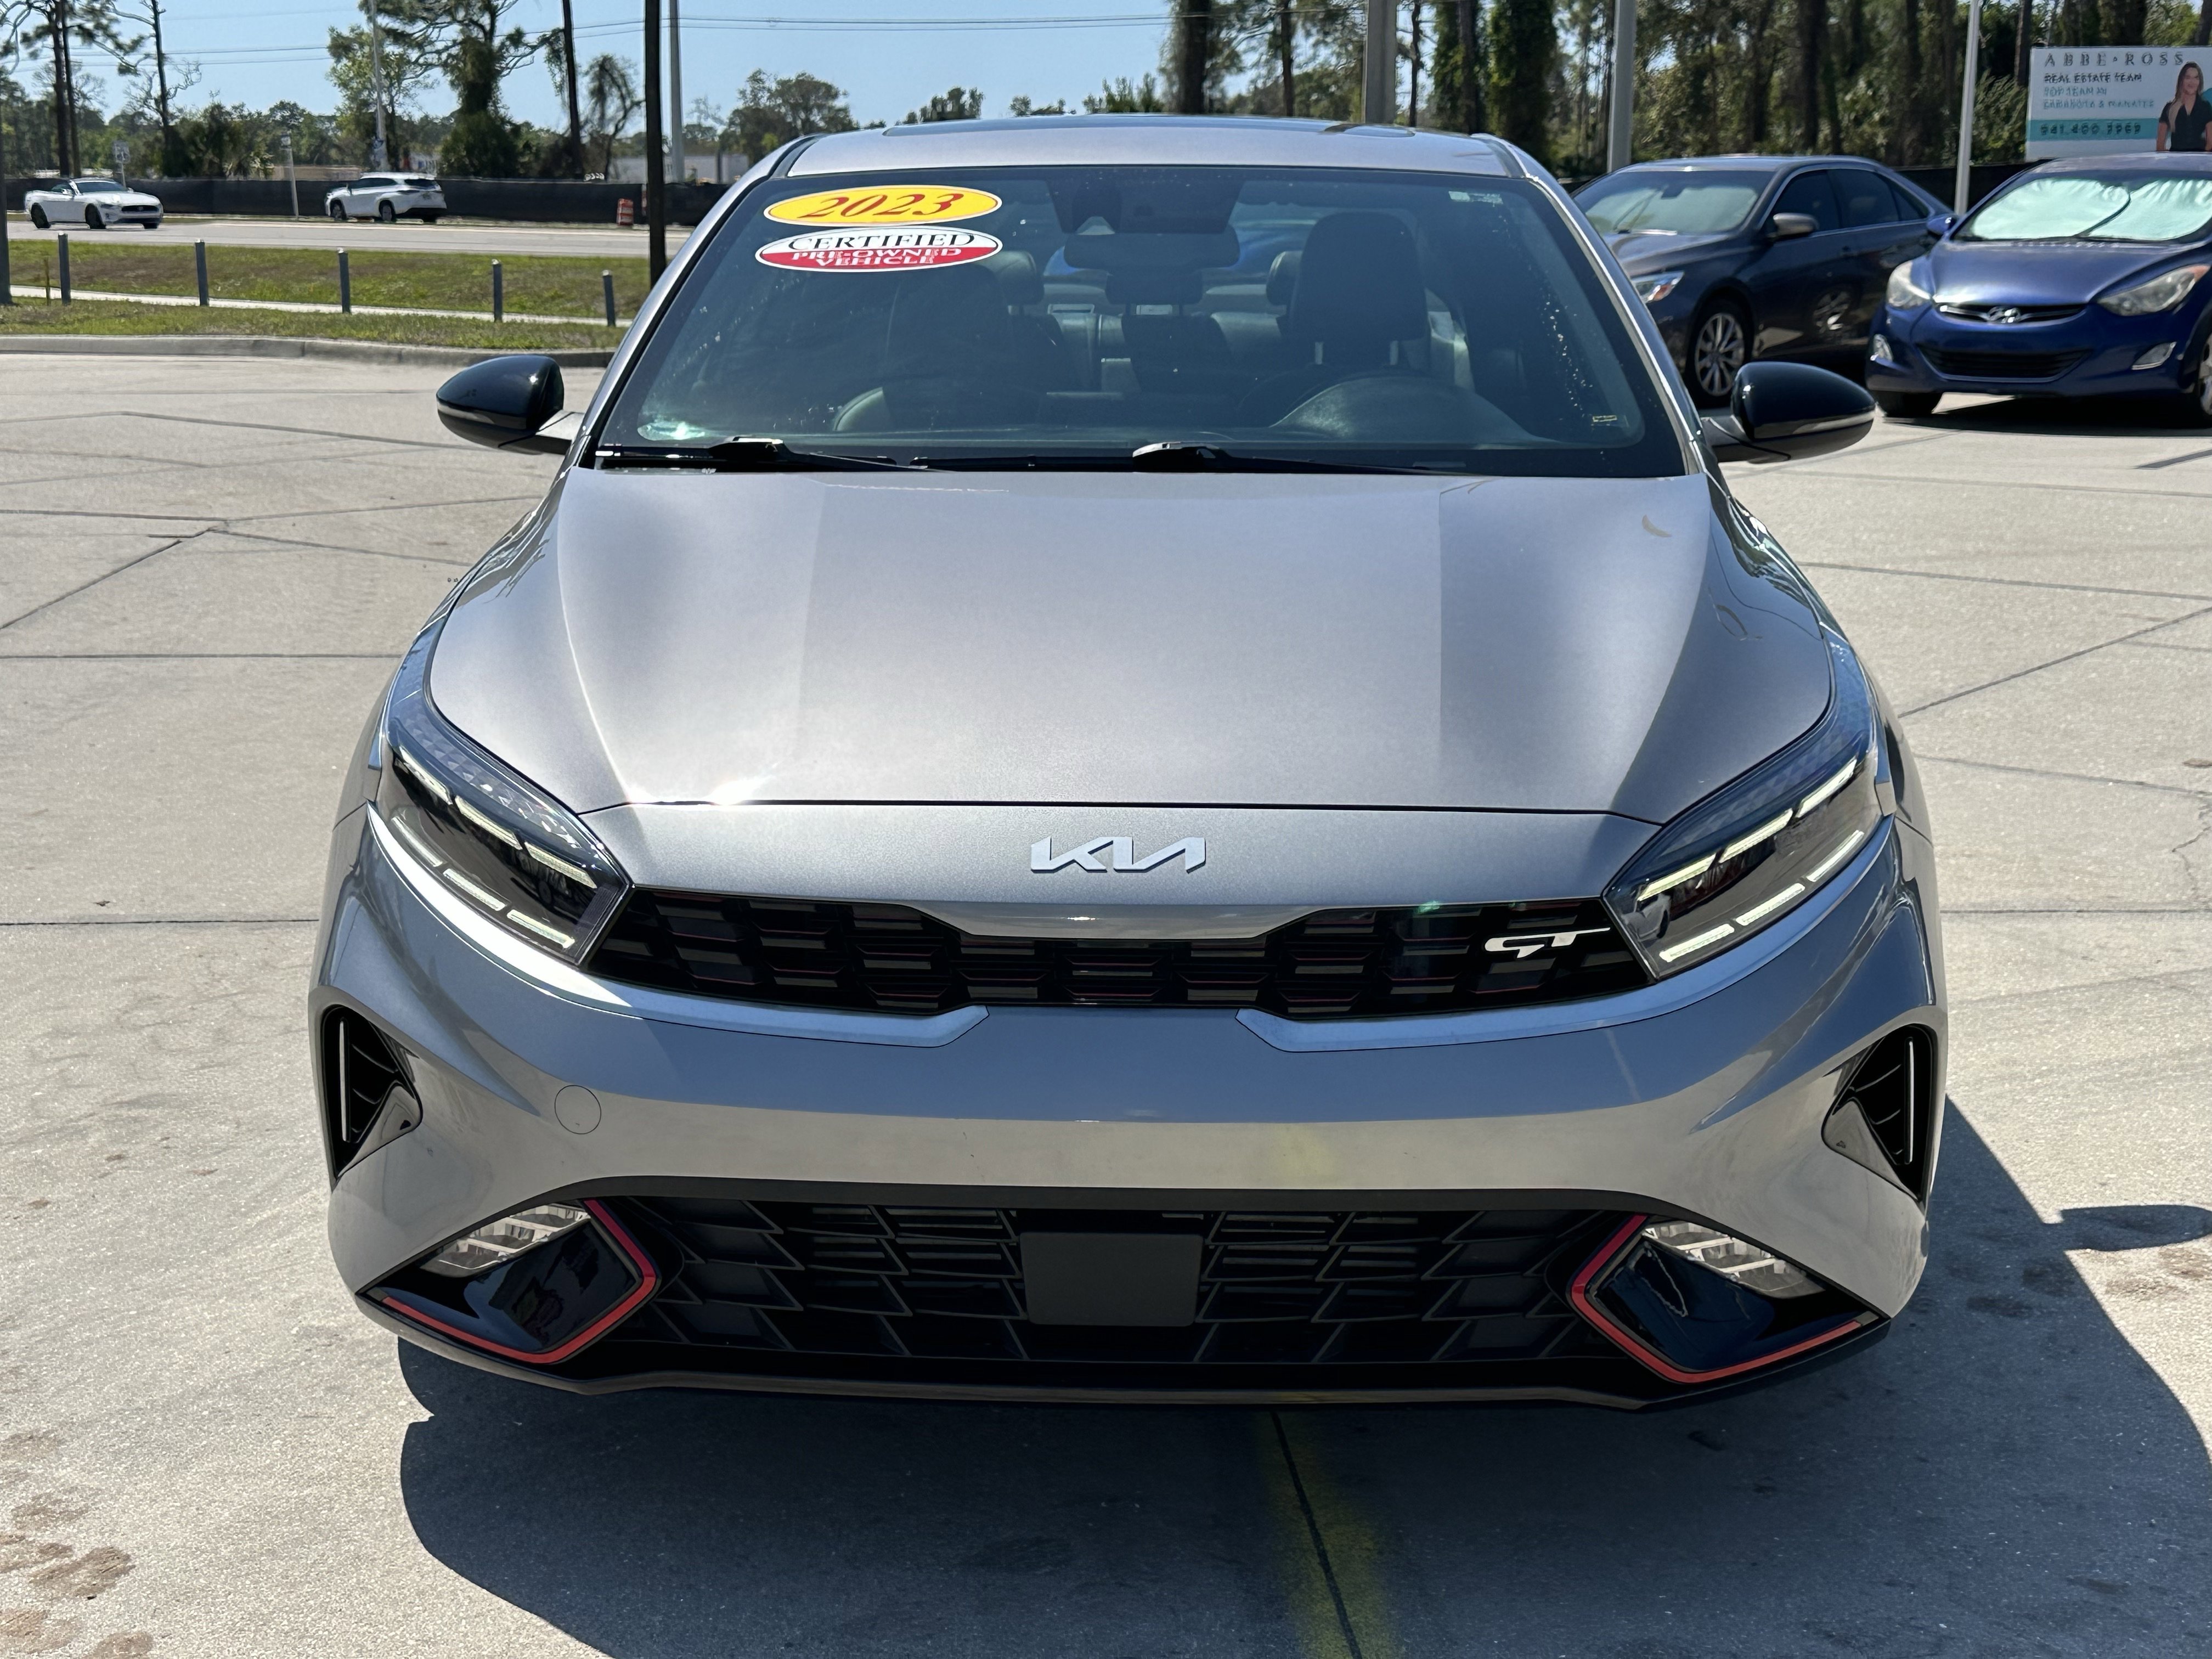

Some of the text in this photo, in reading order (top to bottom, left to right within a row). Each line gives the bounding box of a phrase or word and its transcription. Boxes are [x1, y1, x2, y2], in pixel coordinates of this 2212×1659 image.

[2045, 52, 2183, 66] ABBE ROSS
[2044, 72, 2142, 83] REAL ESTATE TEAM
[796, 193, 964, 218] 2023
[788, 233, 975, 250] CERTIFIED
[792, 248, 962, 261] PRE-OWNED
[816, 255, 934, 266] VEHICLE
[1031, 836, 1206, 873] KIA
[1485, 927, 1611, 958] GT
